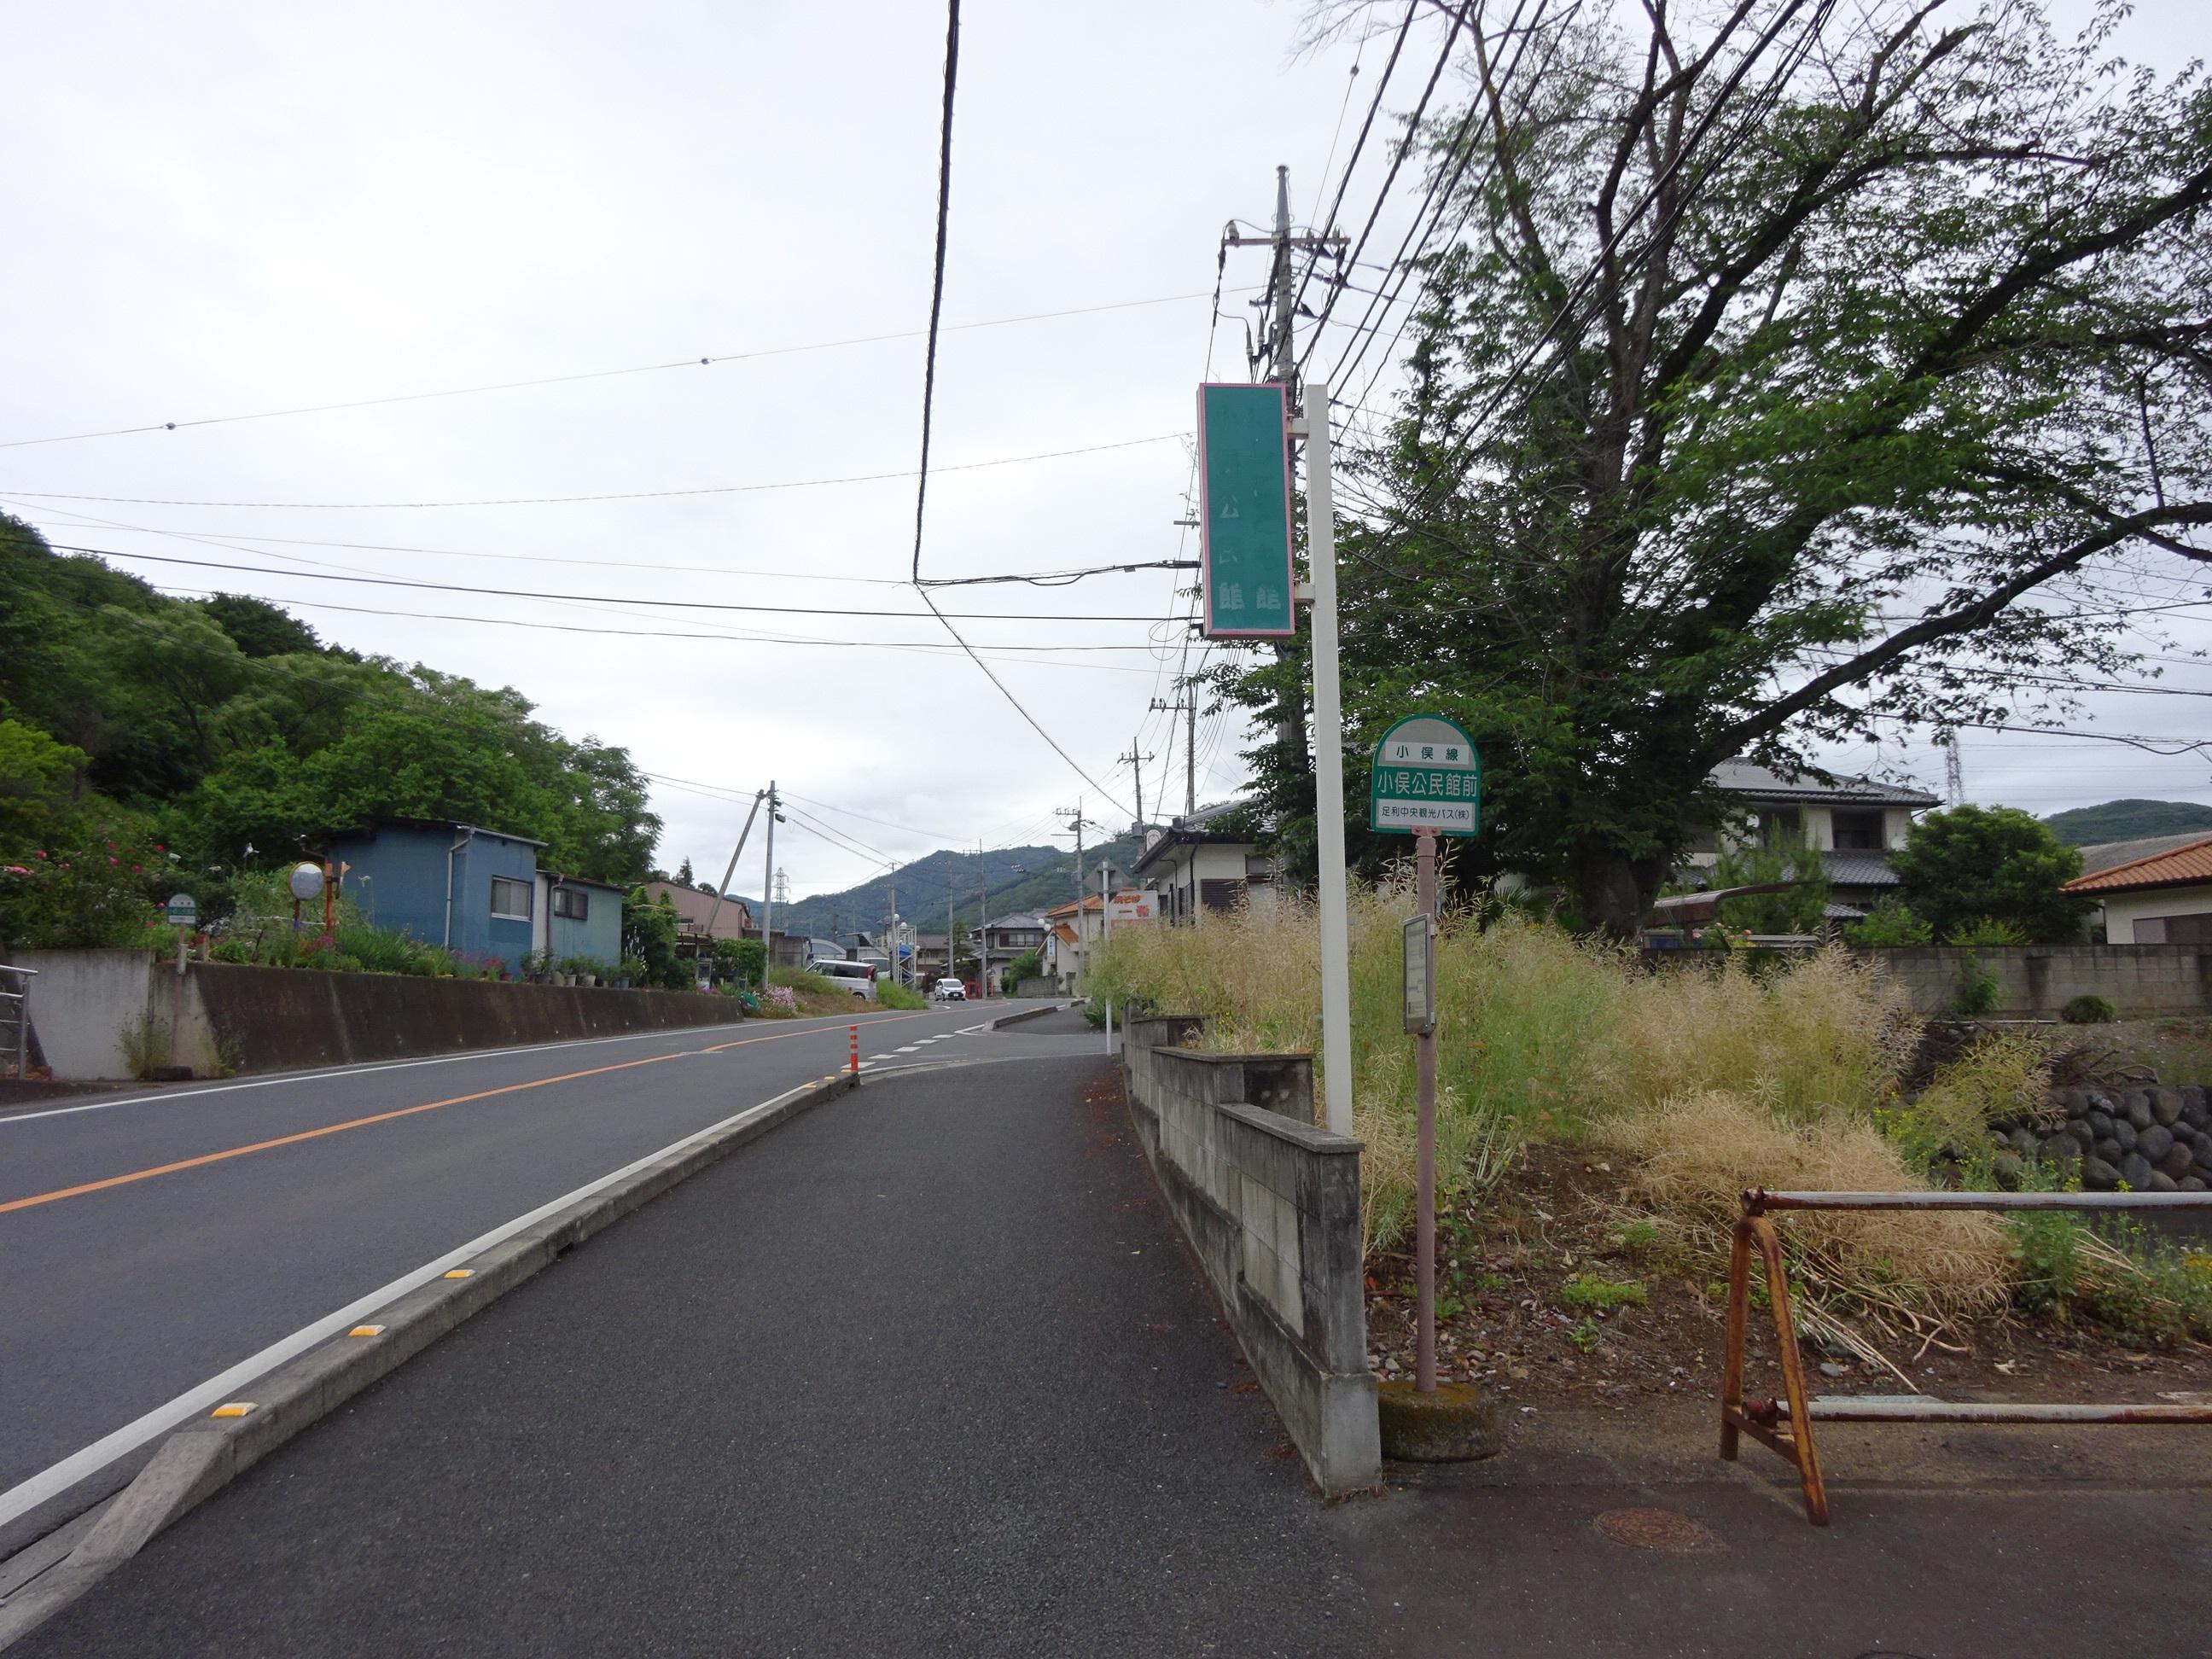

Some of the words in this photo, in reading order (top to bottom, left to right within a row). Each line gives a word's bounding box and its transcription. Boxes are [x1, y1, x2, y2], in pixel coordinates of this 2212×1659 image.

[1396, 745, 1458, 761] 小俣線
[1377, 771, 1477, 796] 小俣公民館前
[1382, 806, 1470, 820] 足利中央観光バス(株)
